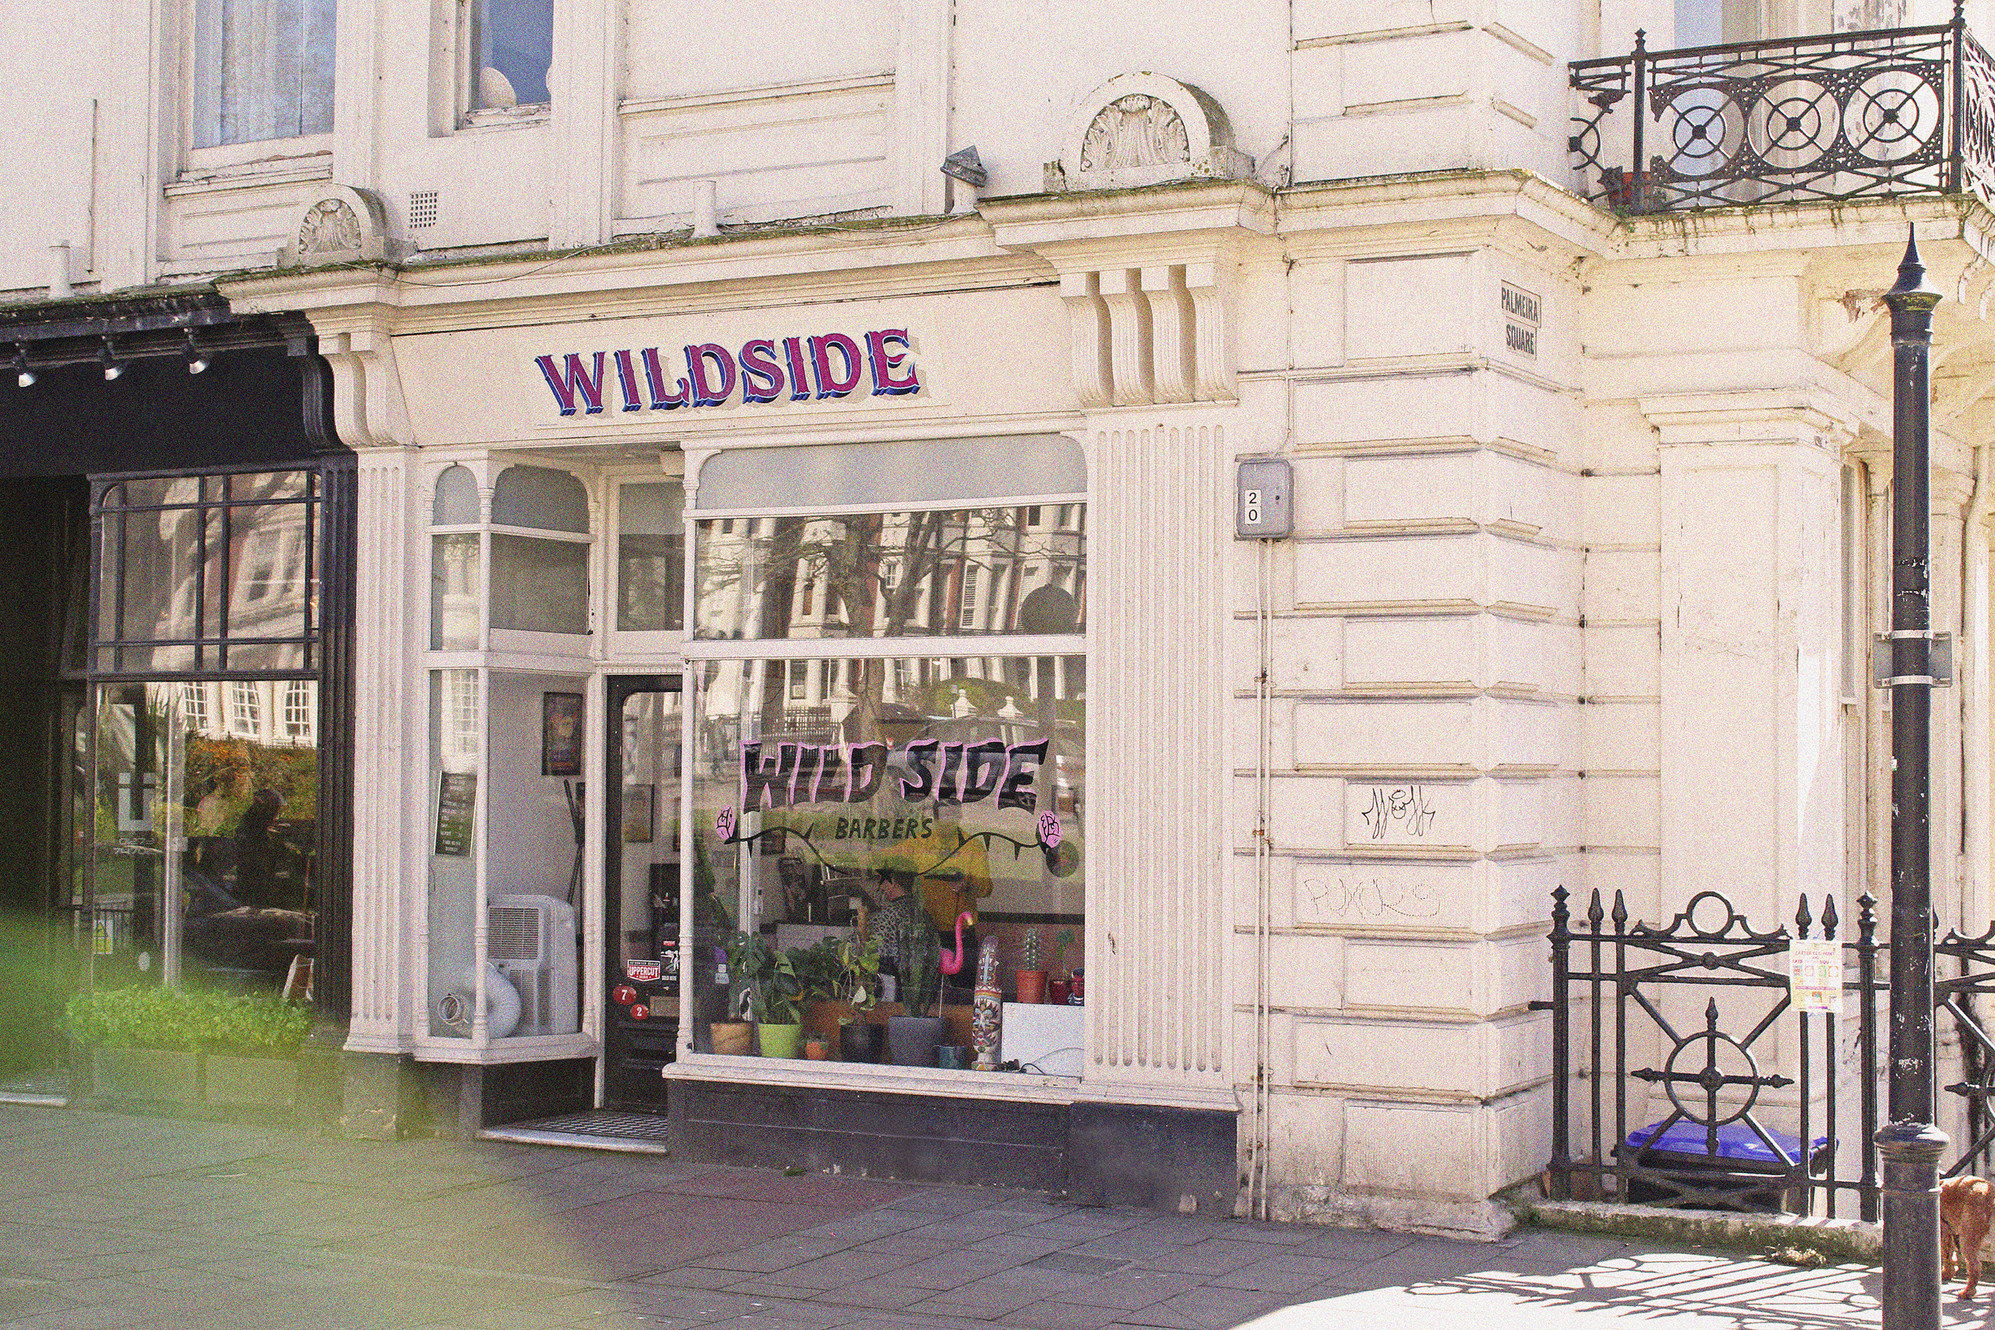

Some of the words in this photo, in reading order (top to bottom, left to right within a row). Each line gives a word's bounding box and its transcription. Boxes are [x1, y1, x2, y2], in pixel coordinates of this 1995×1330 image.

[1501, 287, 1538, 323] PALMEIRA
[1506, 324, 1535, 355] SQUARE
[534, 327, 922, 417] WILDSIDE
[740, 740, 888, 815] WILD
[900, 738, 1049, 815] SIDE
[835, 817, 933, 841] BARBERS
[629, 966, 658, 977] UPPERCUT
[621, 989, 628, 1000] 7
[636, 1006, 642, 1016] 2
